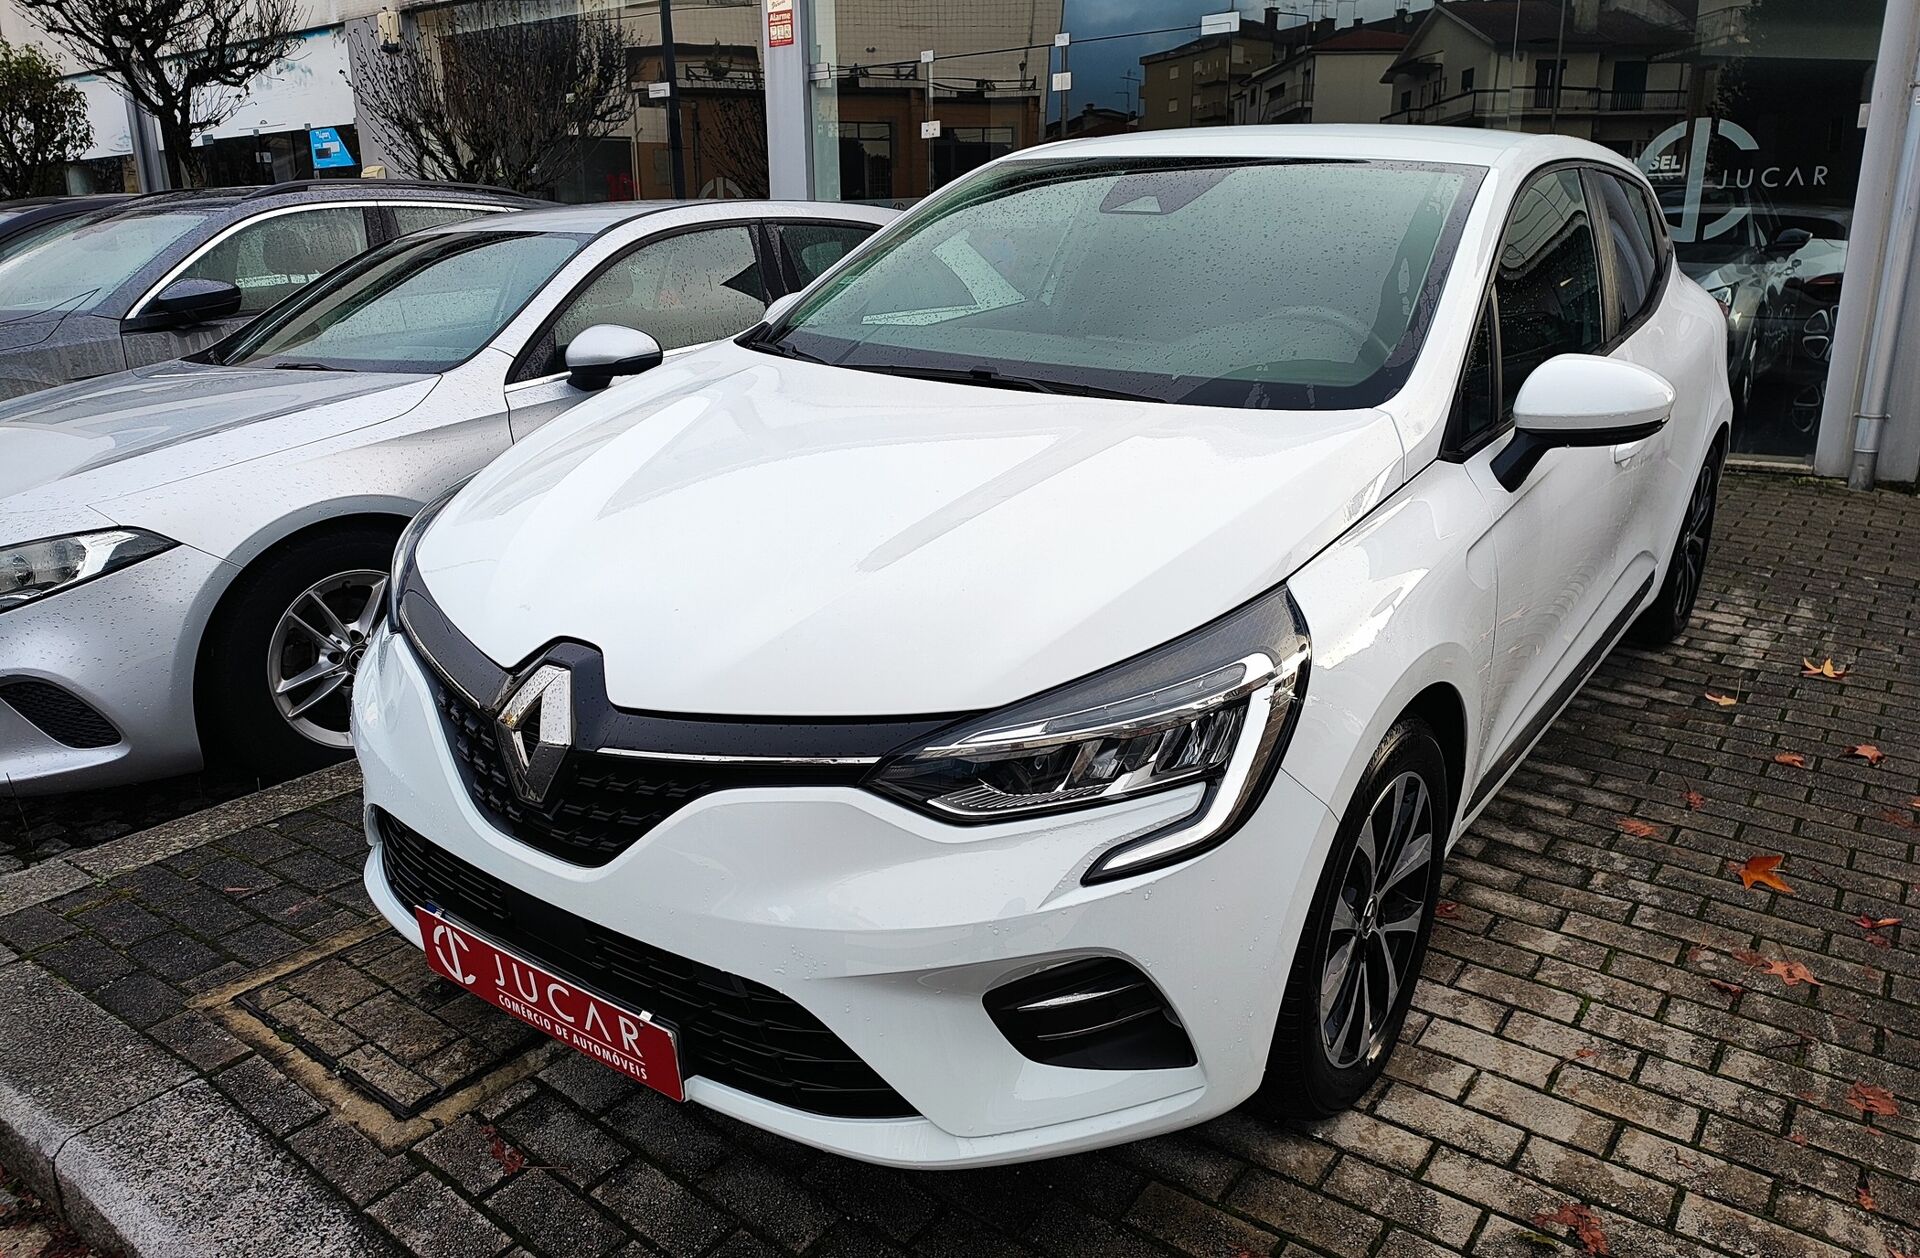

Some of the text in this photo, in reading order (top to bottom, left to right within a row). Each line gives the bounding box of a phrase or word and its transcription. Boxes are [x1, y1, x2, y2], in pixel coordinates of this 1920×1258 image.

[1716, 165, 1829, 190] JUCAR
[494, 953, 644, 1058] JUCAR
[498, 994, 648, 1081] COMÉRCIO DE AUTOMÓVEIS
